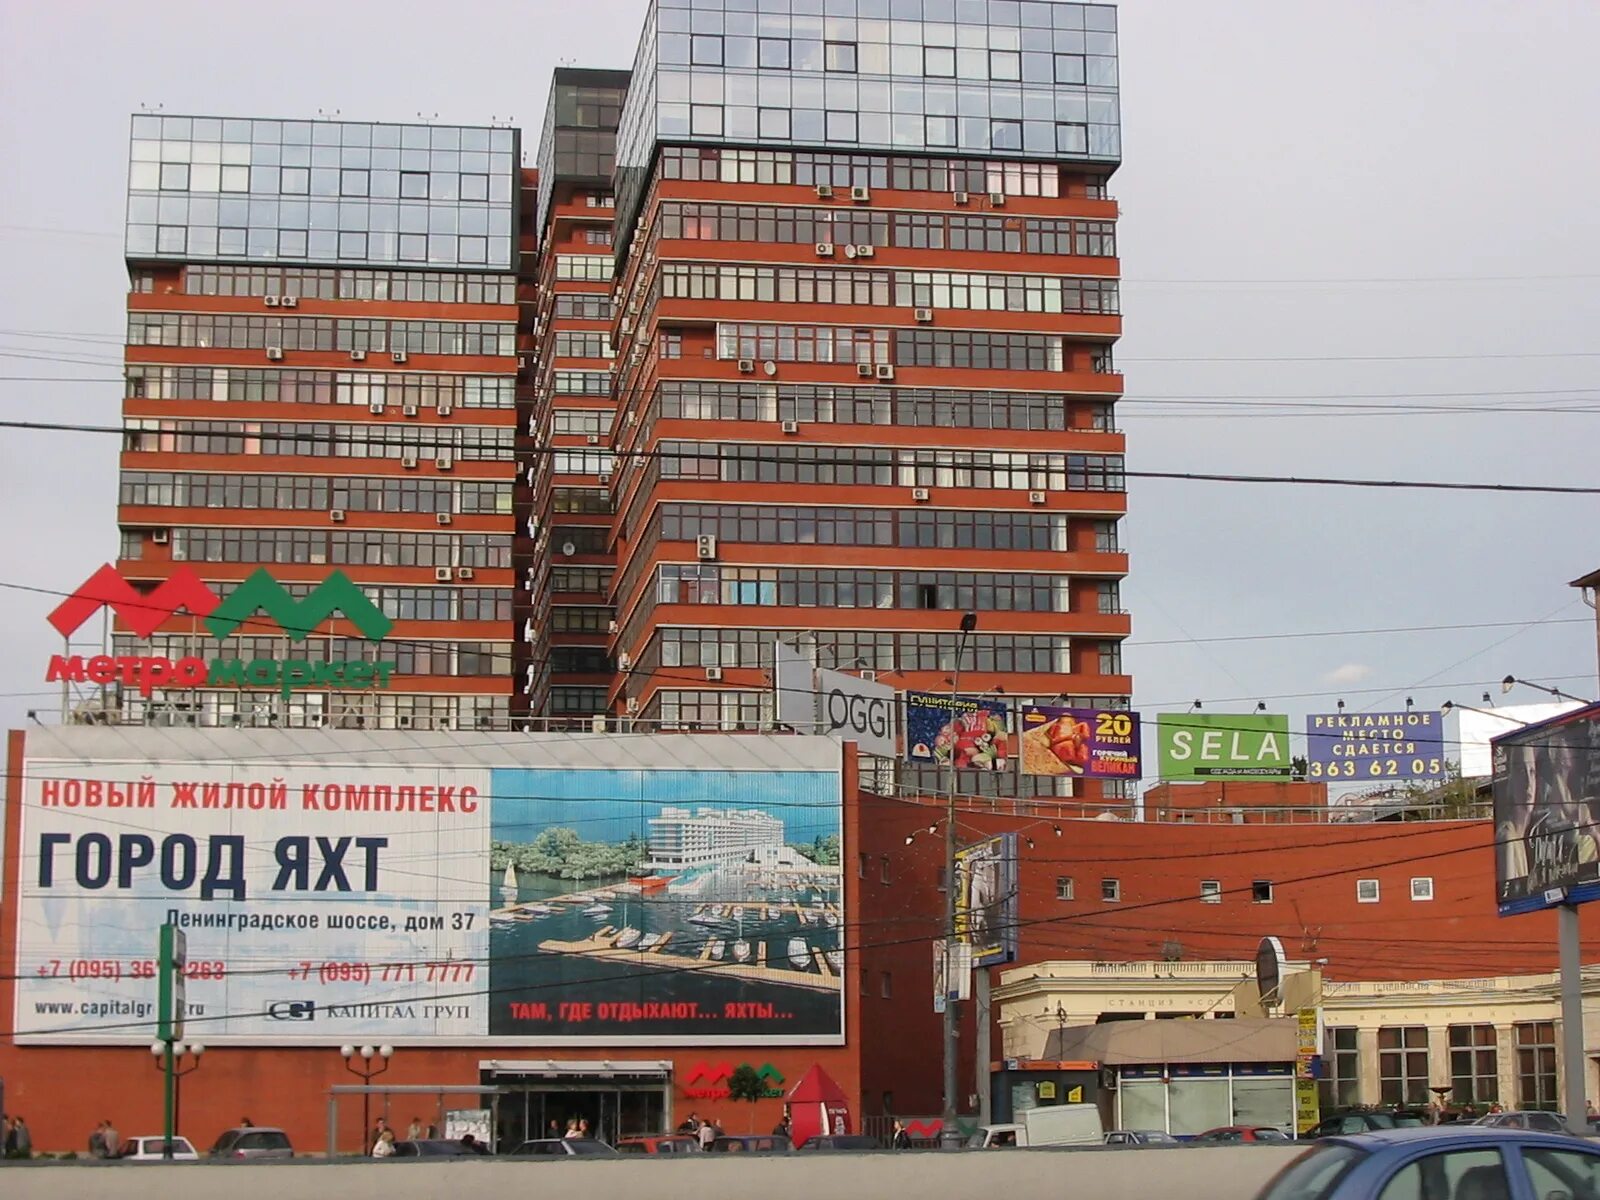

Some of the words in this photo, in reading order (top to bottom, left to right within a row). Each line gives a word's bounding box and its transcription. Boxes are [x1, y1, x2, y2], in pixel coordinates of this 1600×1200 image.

[828, 688, 892, 740] OGGI
[1095, 713, 1132, 736] 20
[1315, 714, 1430, 728] РЕКЛАМНОЕ
[1095, 735, 1132, 744] РУБЛЕЙ
[1342, 729, 1404, 741] МЕСТО
[1170, 730, 1281, 762] SELA
[1332, 743, 1415, 757] СДАЕТСЯ
[1311, 761, 1356, 777] 363
[1369, 760, 1398, 776] 62
[1411, 758, 1440, 775] 05
[42, 776, 156, 809] НОВЫЙ
[171, 777, 287, 811] ЖИЛОЙ
[303, 784, 478, 814] КОМПЛЕКС
[38, 832, 247, 901] ГОРОД
[271, 837, 389, 893] ЯХТ
[167, 909, 319, 931] Ленинградское
[327, 913, 396, 932] шоссе,
[404, 914, 444, 931] дом
[451, 913, 475, 930] 37
[37, 960, 61, 978] +7
[69, 960, 121, 983] (095)
[130, 961, 160, 979] 36
[287, 962, 312, 980] +7
[320, 962, 370, 985] (095)
[380, 964, 415, 982] 771
[425, 963, 475, 982] 7777
[36, 1000, 204, 1017] www.capitalgr.ru
[328, 1004, 416, 1018] КАПИТАЛ
[424, 1005, 470, 1019] ГРУП
[510, 1002, 552, 1021] ТАМ,
[559, 1003, 592, 1022] ГДЕ
[597, 1003, 718, 1022] ОТДЫХАЮТ...
[724, 1003, 794, 1019] ЯХТЫ...
